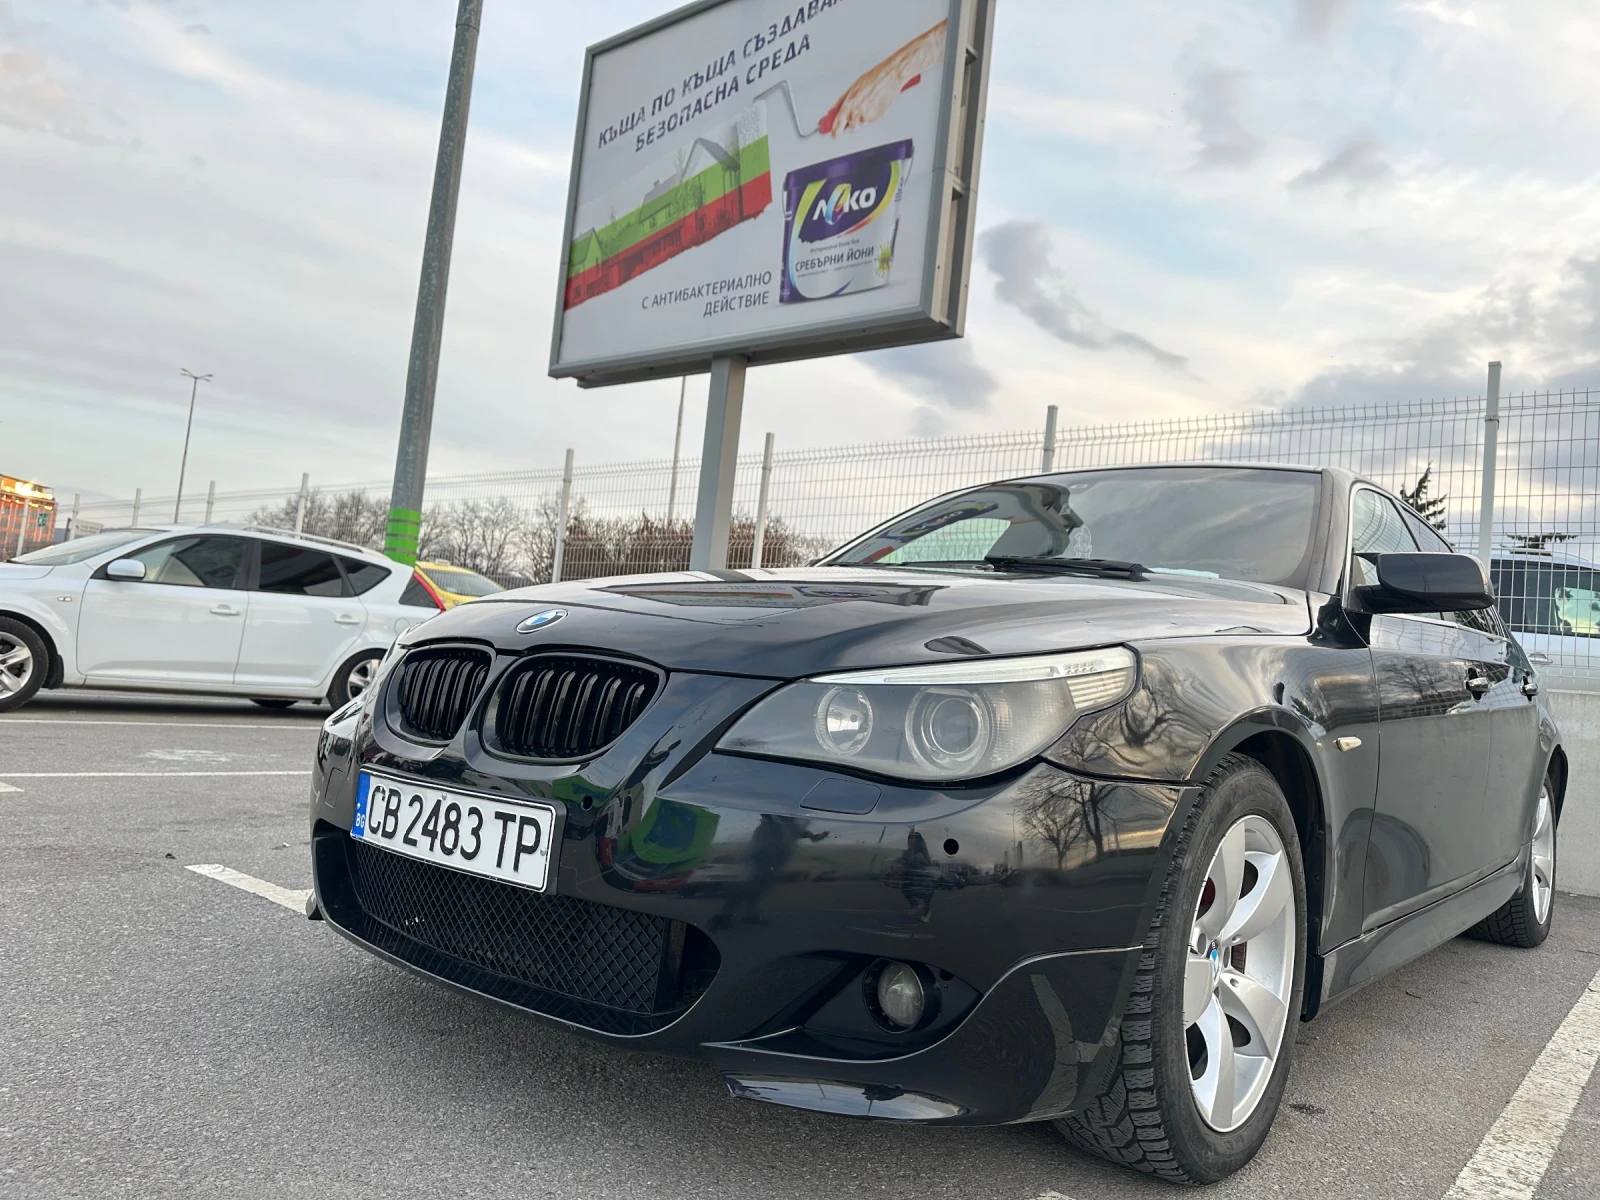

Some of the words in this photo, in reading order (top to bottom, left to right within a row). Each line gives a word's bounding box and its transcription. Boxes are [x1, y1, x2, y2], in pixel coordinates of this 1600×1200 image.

[598, 106, 646, 149] КЪЩА
[650, 86, 676, 117] ПО
[682, 50, 737, 99] КЪЩА
[742, 0, 843, 59] СЪЗДАВА
[635, 76, 741, 152] БЕЗОПАСНА
[745, 33, 812, 86] СРЕДА
[795, 253, 844, 272] СРЕБЪРНИ
[846, 245, 874, 262] ЙОНИ
[641, 296, 649, 310] С
[652, 270, 772, 306] АНТИБАКТЕРИАЛНО
[703, 290, 769, 317] ДЕЙСТВИЕ
[355, 812, 366, 828] BG
[495, 810, 542, 873] TP
